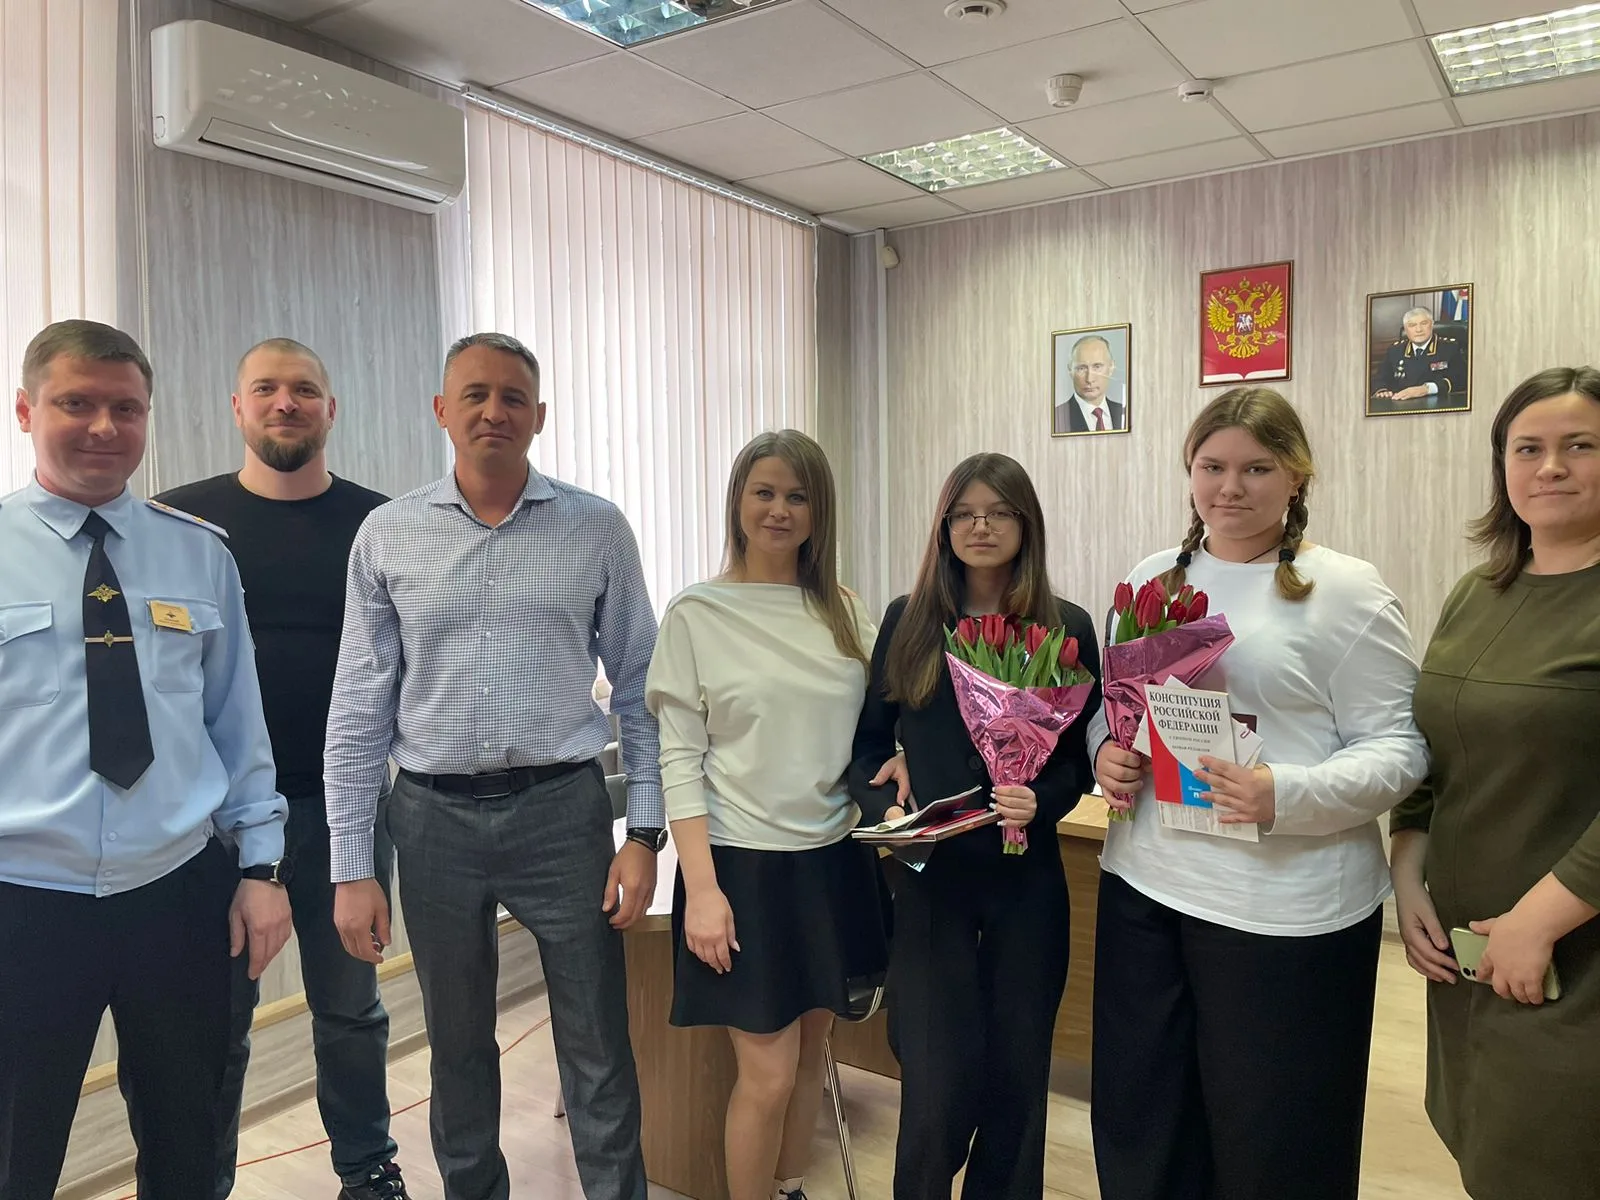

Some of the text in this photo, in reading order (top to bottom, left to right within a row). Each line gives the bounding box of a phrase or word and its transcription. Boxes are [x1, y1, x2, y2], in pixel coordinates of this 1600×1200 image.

[1149, 691, 1221, 708] КОНСТИТУЦИЯ
[1153, 705, 1221, 721] РОССИЙСКОЙ
[1158, 719, 1219, 734] ФЕДЕРАЦИИ
